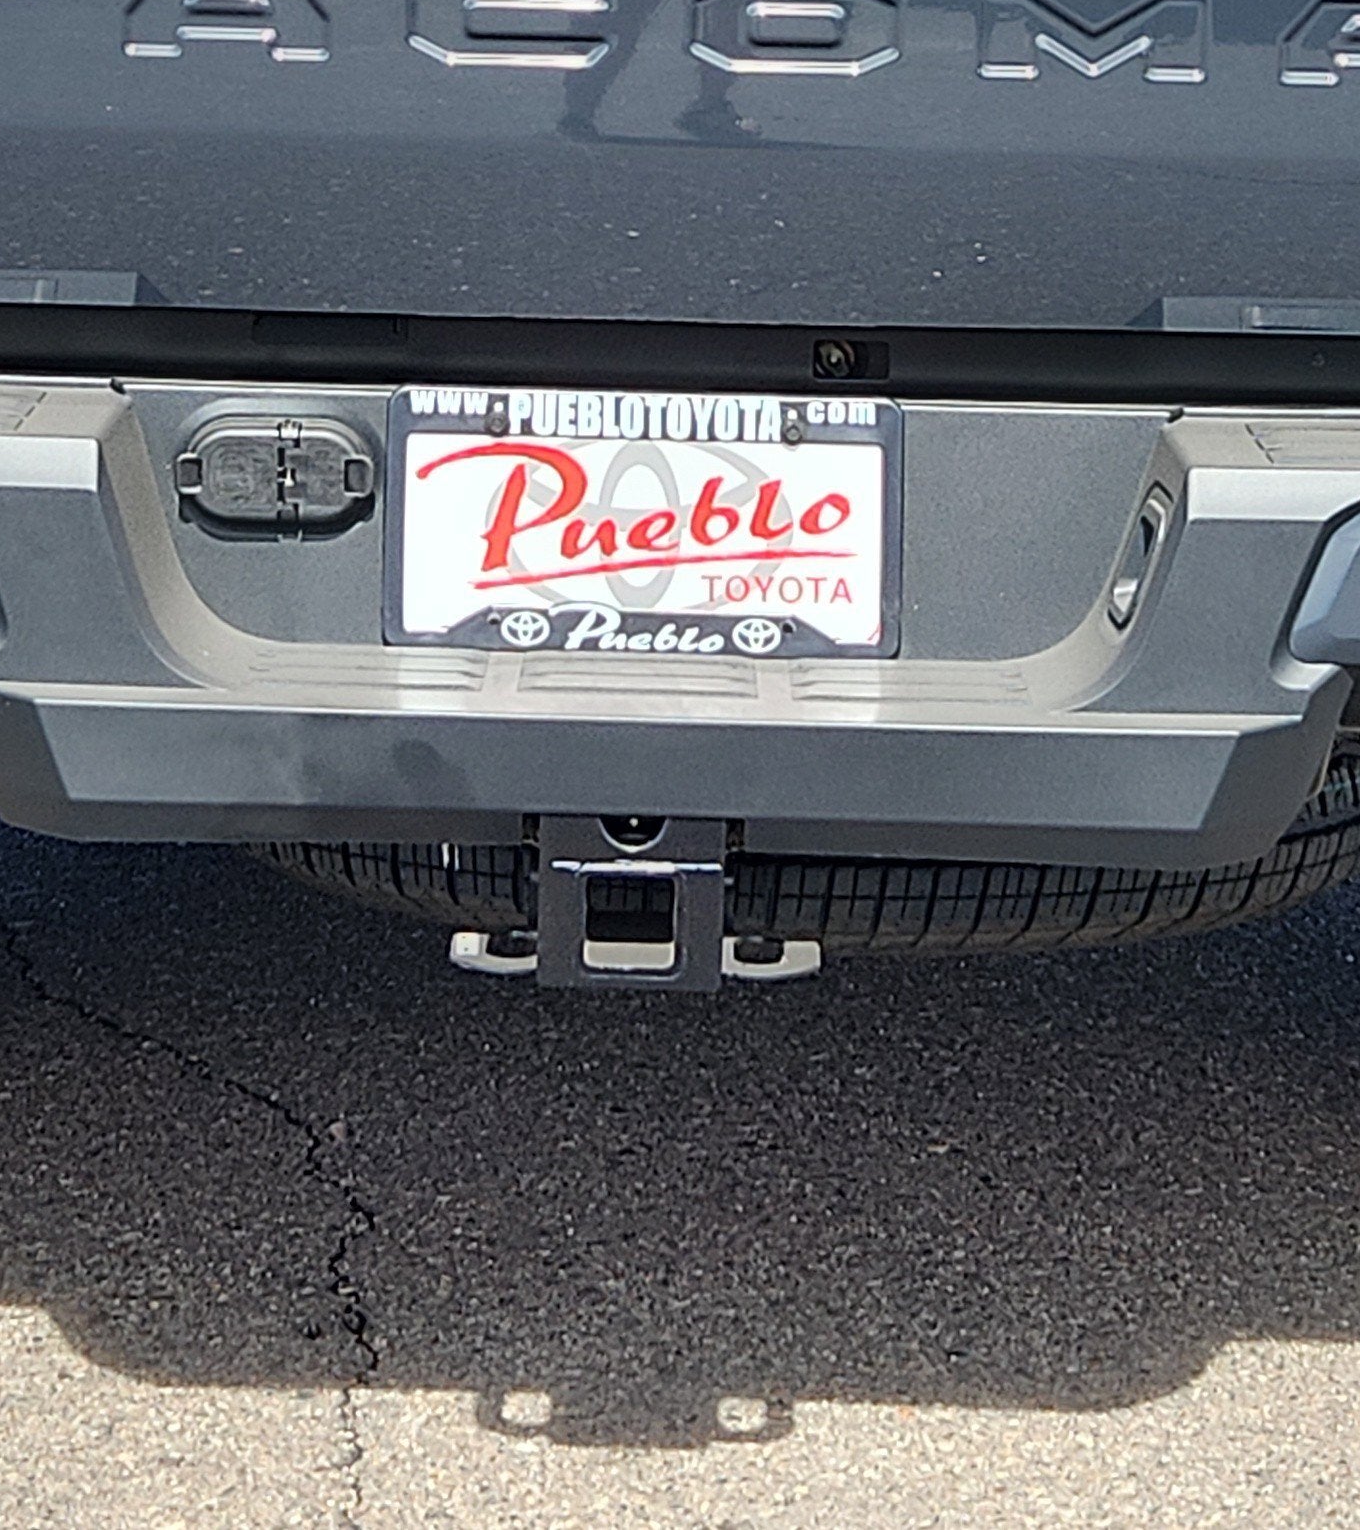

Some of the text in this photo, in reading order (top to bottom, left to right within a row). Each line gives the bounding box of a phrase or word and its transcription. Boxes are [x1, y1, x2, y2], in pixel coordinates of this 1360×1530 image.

[415, 442, 853, 572] Pueblo
[701, 575, 853, 605] TOYOTA
[549, 602, 725, 652] Pueblo
